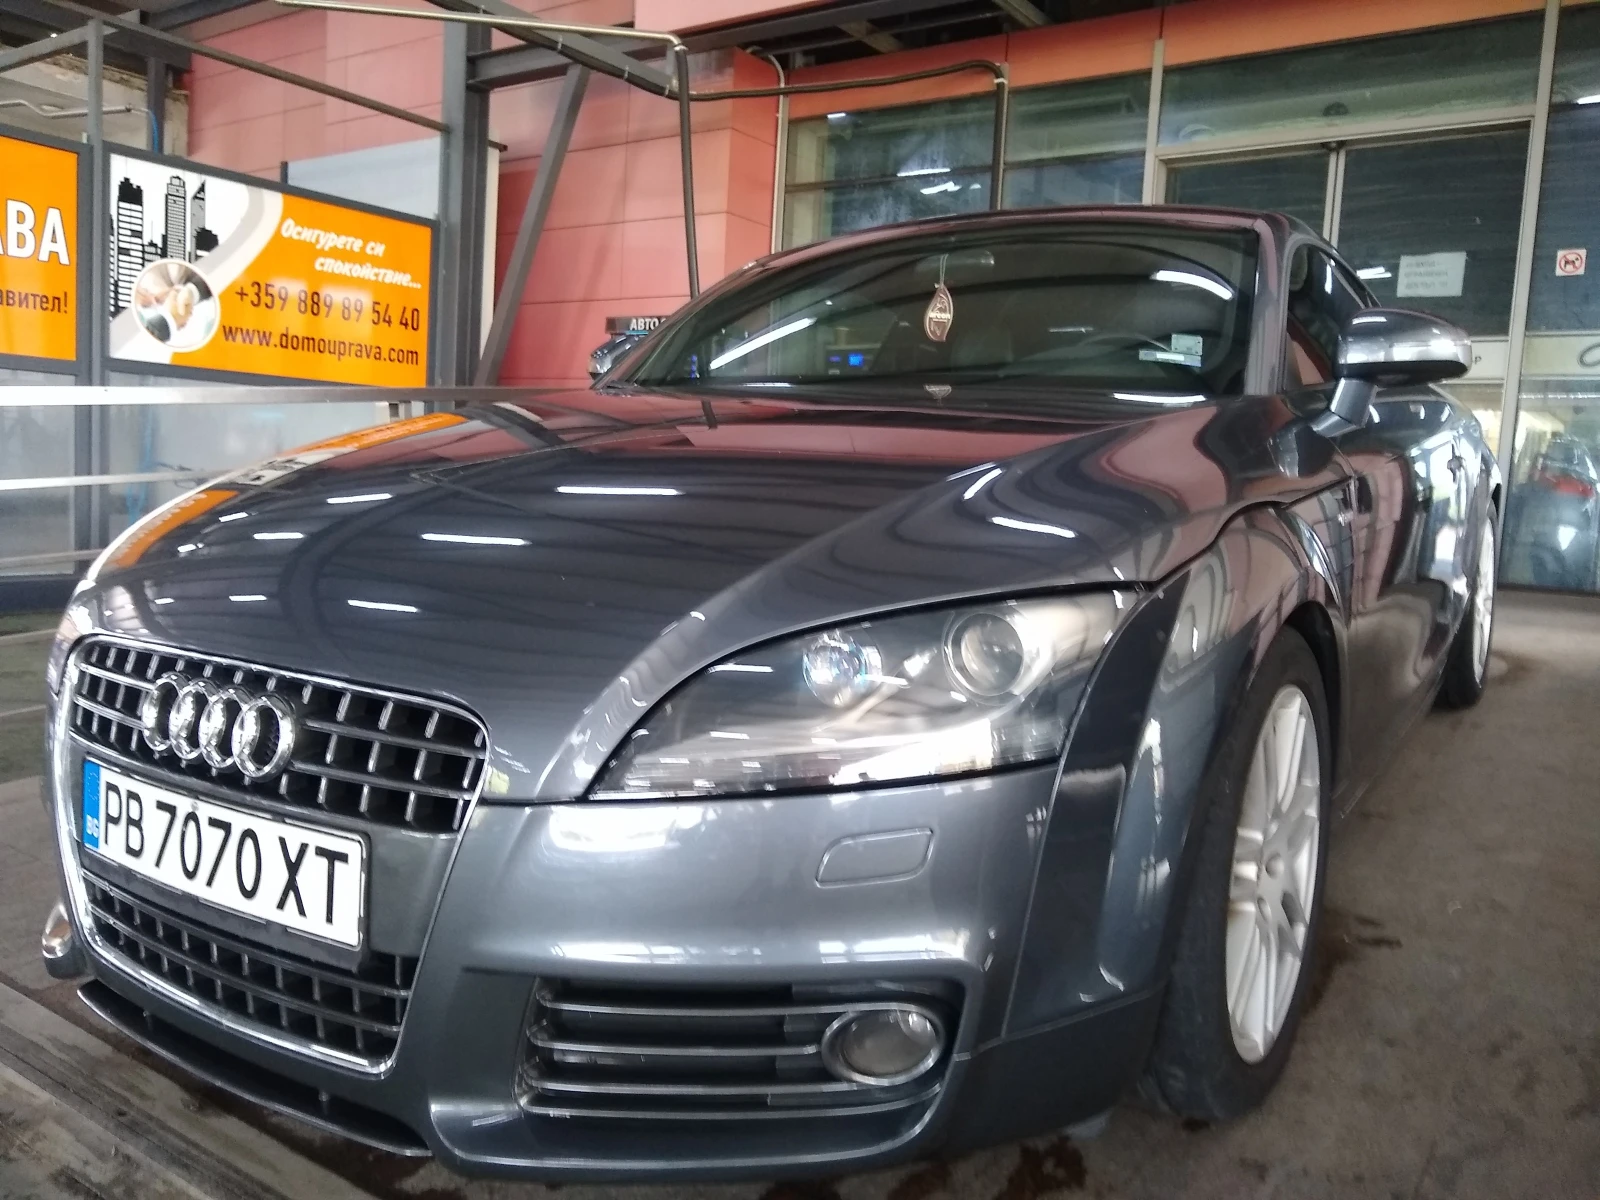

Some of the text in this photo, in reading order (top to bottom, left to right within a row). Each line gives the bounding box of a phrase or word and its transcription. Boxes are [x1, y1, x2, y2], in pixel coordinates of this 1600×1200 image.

[0, 198, 71, 266] ВА
[281, 217, 386, 257] Осигурете си
[314, 256, 422, 289] спокойствие...
[235, 281, 421, 332] +359 889 89 54 40
[222, 325, 420, 366] www.domouprava.com
[104, 781, 349, 926] PB 7070 XT
